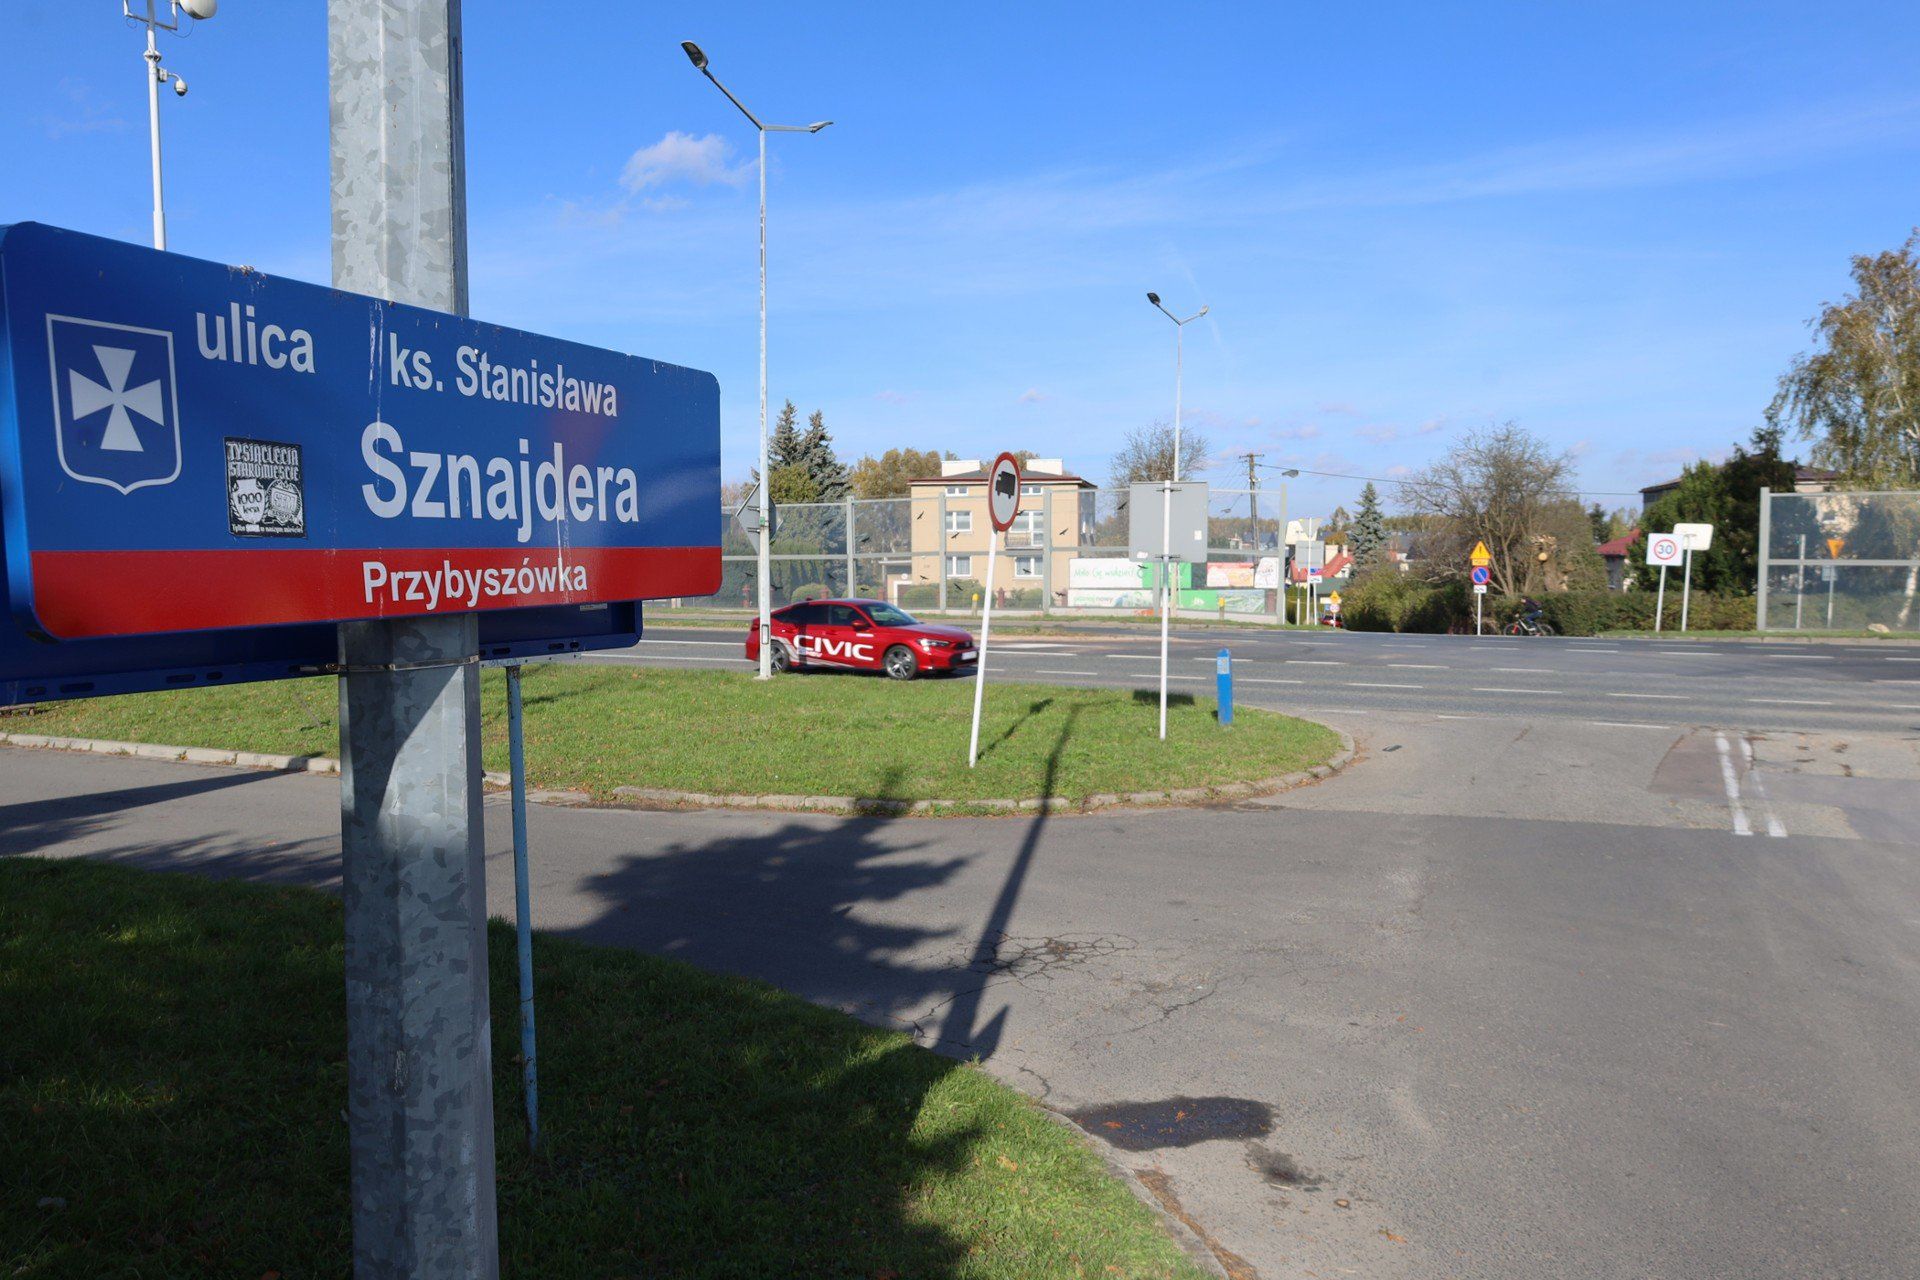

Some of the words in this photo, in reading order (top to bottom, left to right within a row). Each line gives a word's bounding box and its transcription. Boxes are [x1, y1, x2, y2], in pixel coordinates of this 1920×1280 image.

[196, 302, 316, 374] ulica
[390, 332, 444, 392] ks.
[456, 345, 618, 417] Stanisława
[237, 492, 263, 505] 1000
[361, 421, 640, 543] Sznajdera
[1658, 544, 1673, 554] 30
[362, 557, 588, 611] Przybyszówka
[793, 634, 874, 661] CIVIC
